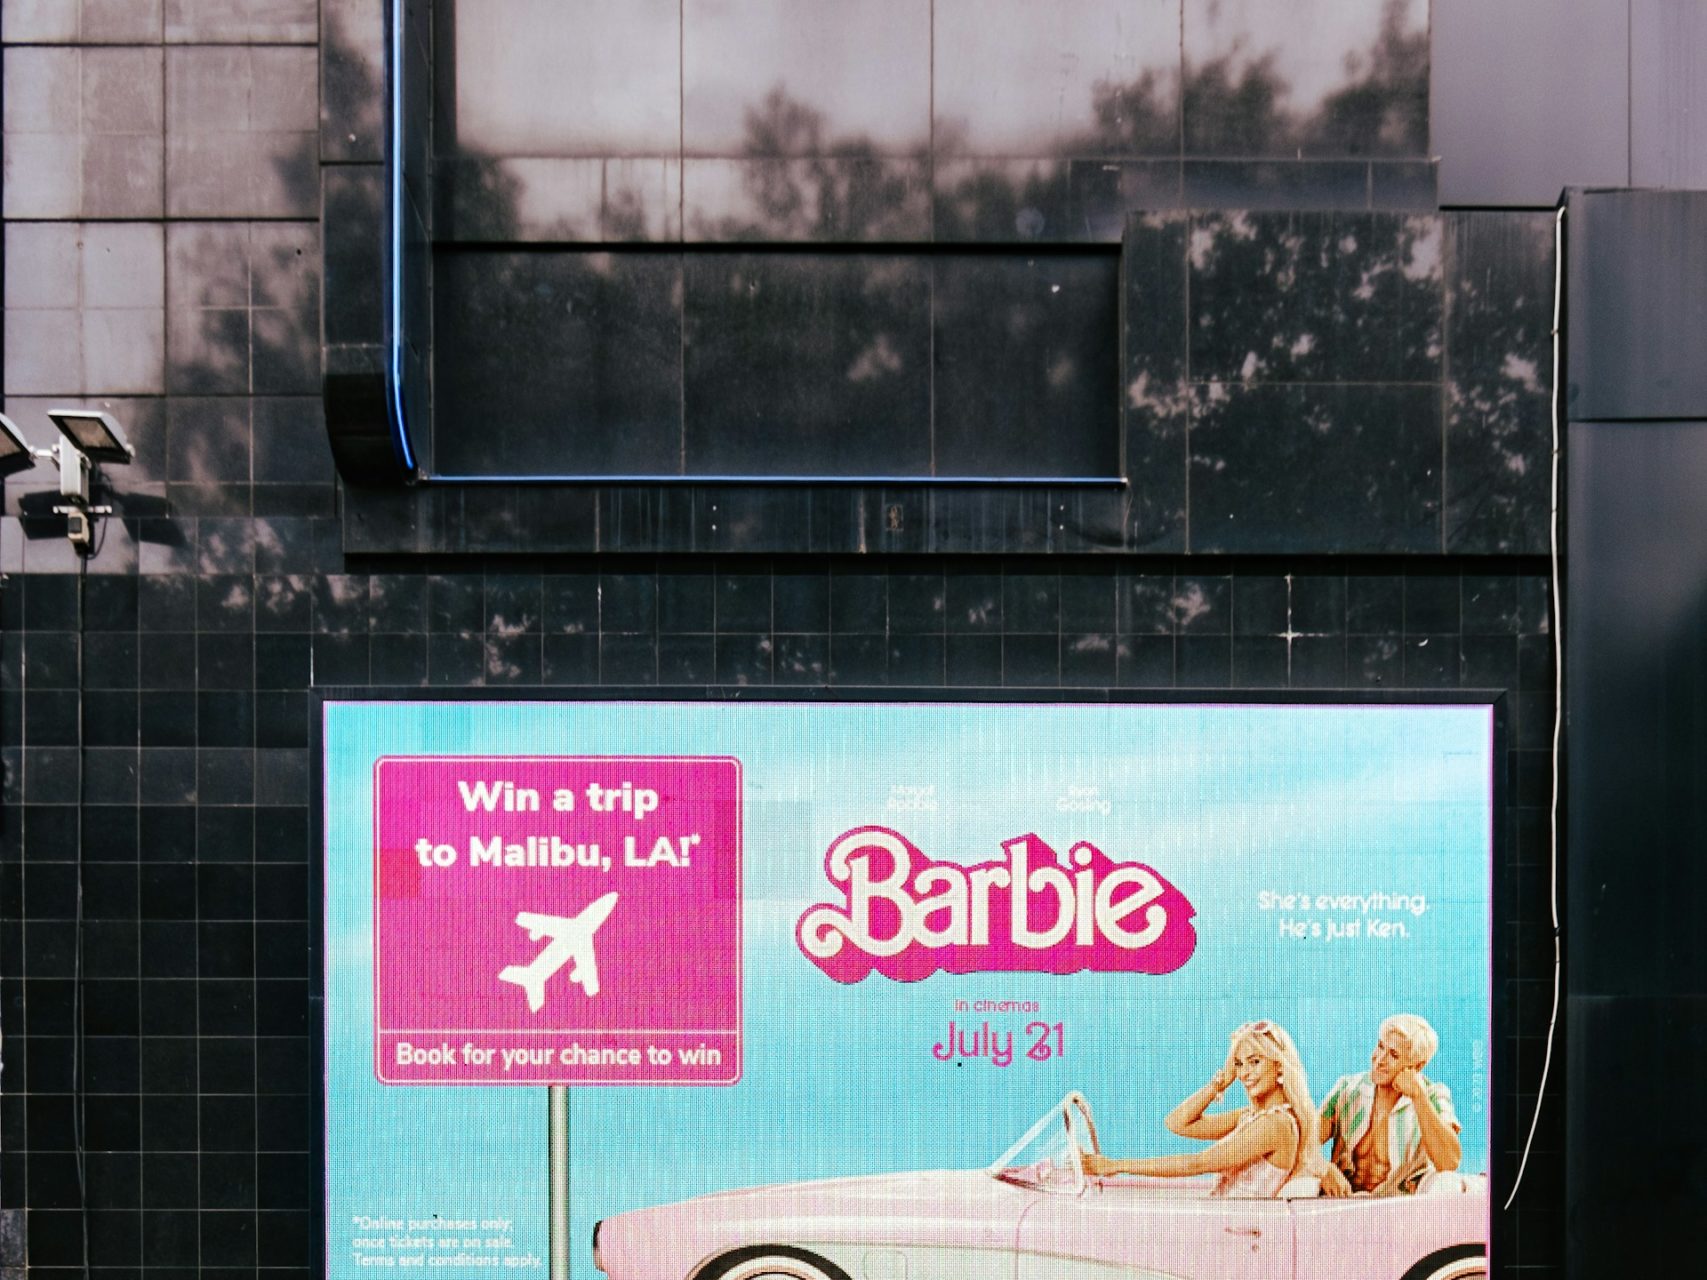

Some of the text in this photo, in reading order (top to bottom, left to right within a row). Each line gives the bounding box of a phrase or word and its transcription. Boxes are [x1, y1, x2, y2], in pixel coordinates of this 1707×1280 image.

[458, 781, 659, 820] Win a trip
[415, 838, 457, 867] to
[470, 836, 611, 872] Malibu,
[800, 829, 1172, 962] Barbie
[1258, 890, 1430, 917] She's everything.
[1279, 917, 1410, 942] He's just Ken.
[973, 999, 1040, 1013] cinemas
[397, 1042, 721, 1071] Book for your chance to win
[932, 1021, 1064, 1067] July 21
[389, 1235, 434, 1249] tickets
[438, 1237, 459, 1249] are
[463, 1237, 481, 1249] on
[352, 1253, 395, 1266] Terms
[398, 1253, 424, 1266] and
[428, 1252, 499, 1267] conditions
